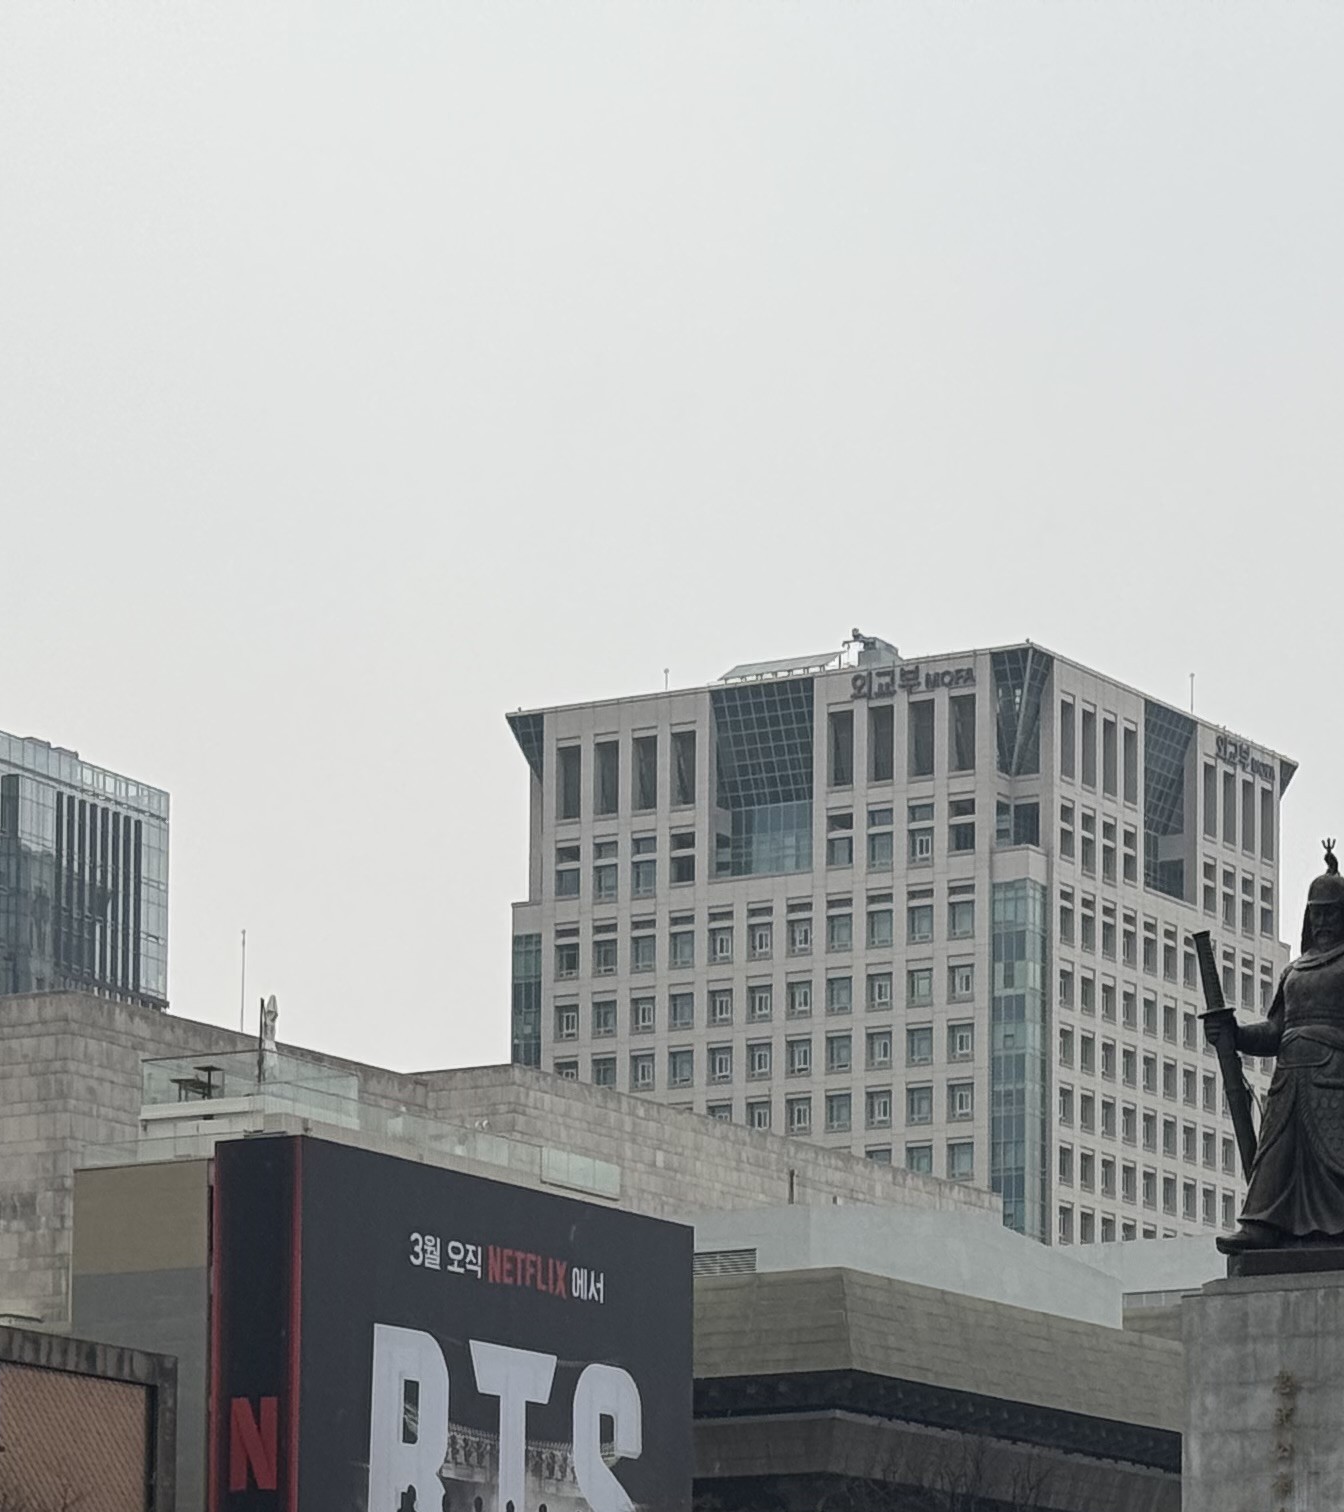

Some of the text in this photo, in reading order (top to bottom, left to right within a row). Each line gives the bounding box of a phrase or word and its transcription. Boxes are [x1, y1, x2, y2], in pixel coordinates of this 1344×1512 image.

[849, 665, 976, 700] 외교부 MOFA
[409, 1231, 605, 1304] 3월 오직 NETFLIX 에서
[228, 1395, 279, 1492] N
